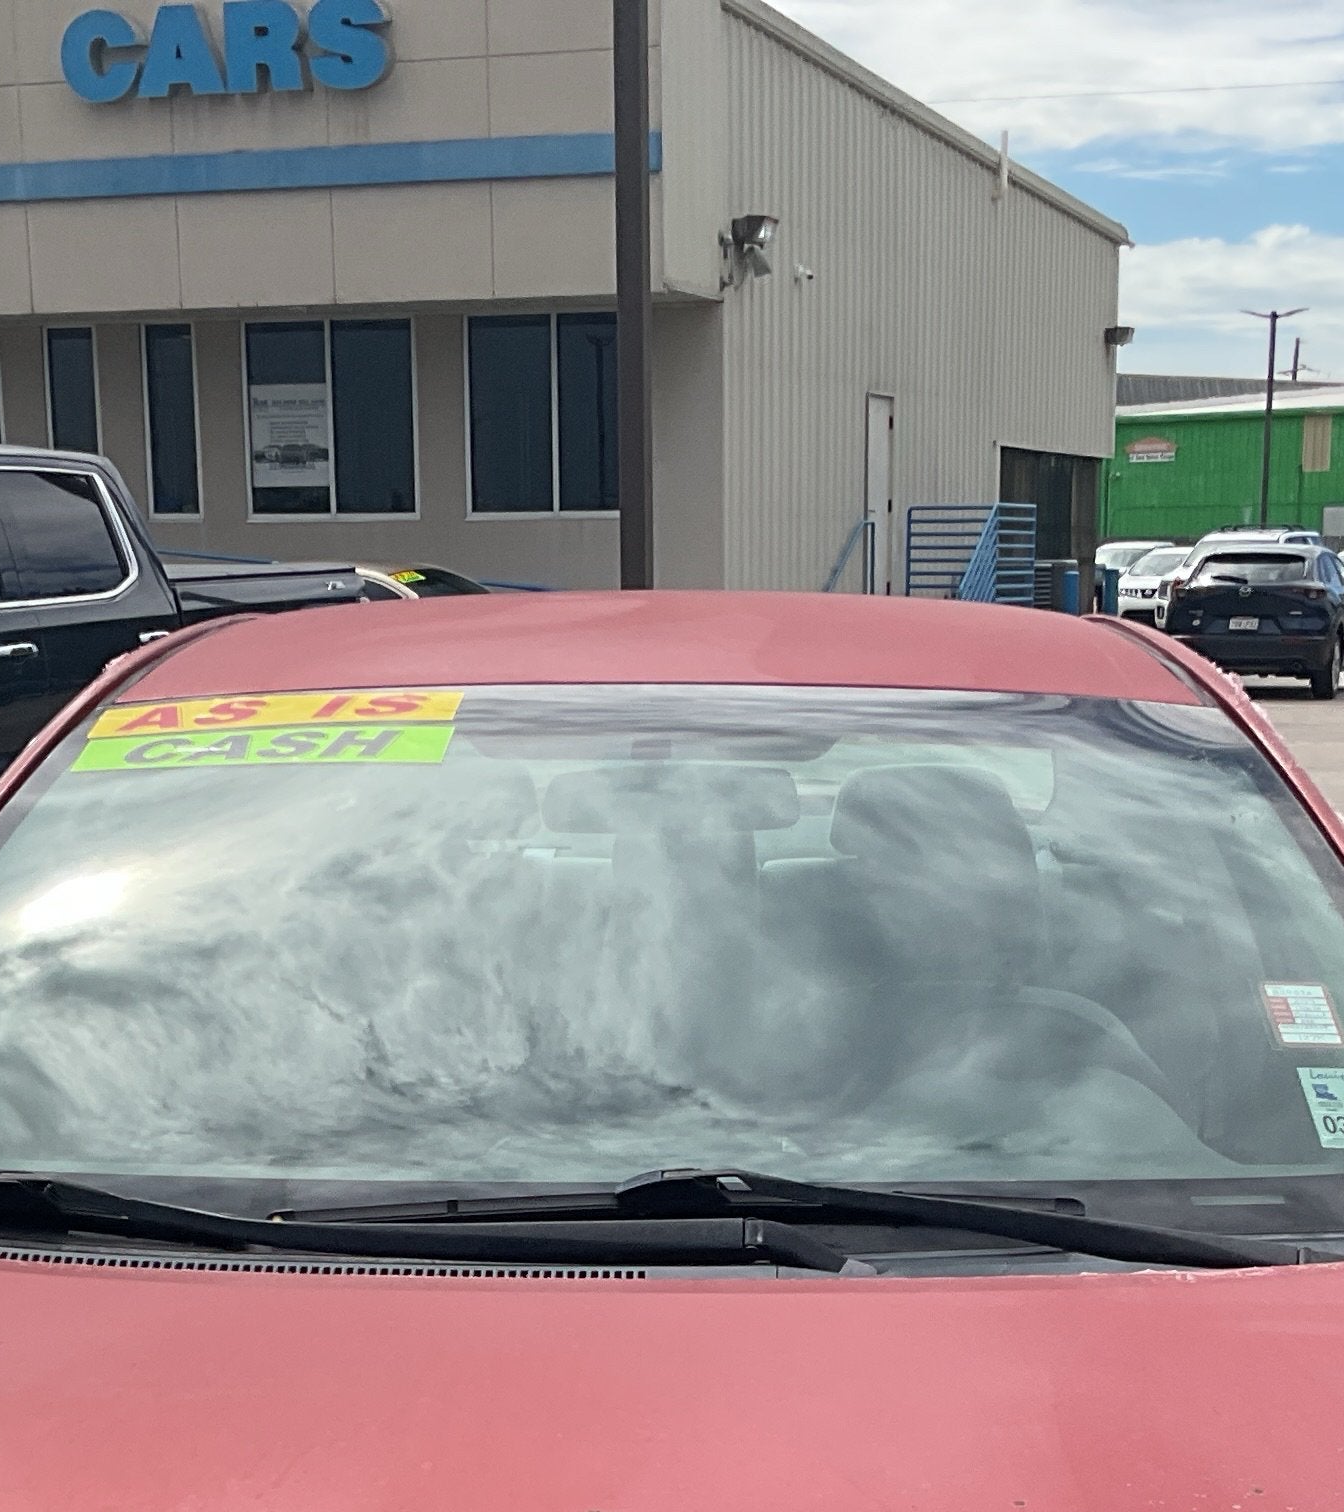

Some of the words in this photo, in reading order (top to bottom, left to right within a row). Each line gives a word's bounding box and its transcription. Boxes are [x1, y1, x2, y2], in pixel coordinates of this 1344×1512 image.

[61, 0, 391, 104] CARS
[117, 700, 267, 731] AS
[311, 695, 427, 717] IS
[125, 730, 402, 764] CASH
